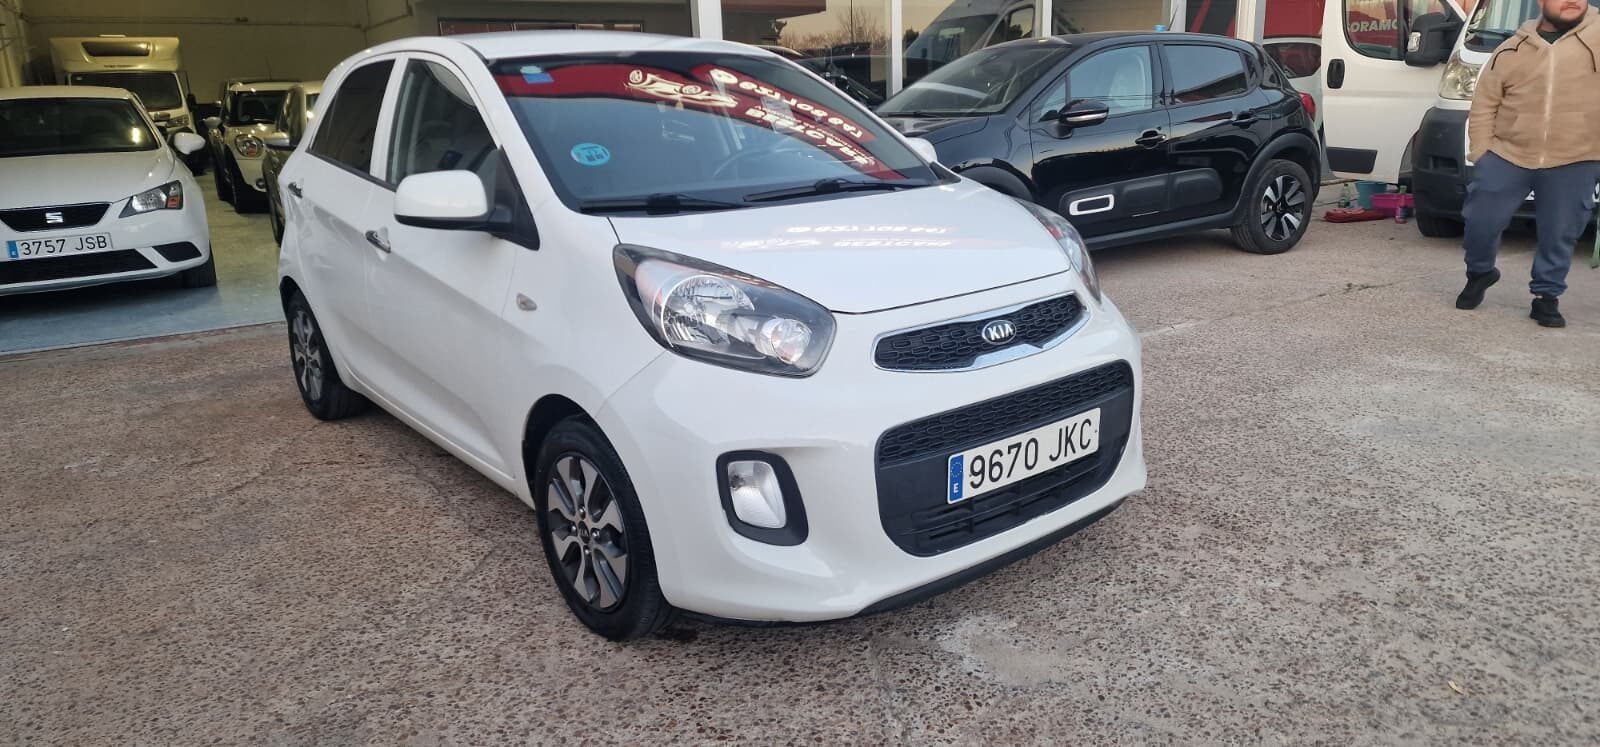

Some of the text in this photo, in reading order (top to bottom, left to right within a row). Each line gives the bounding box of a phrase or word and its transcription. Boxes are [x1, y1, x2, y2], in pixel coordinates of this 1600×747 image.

[20, 235, 108, 256] 3757 JSB
[987, 323, 1013, 341] KIA
[969, 418, 1092, 489] 9670 JKC
[953, 482, 960, 494] E
